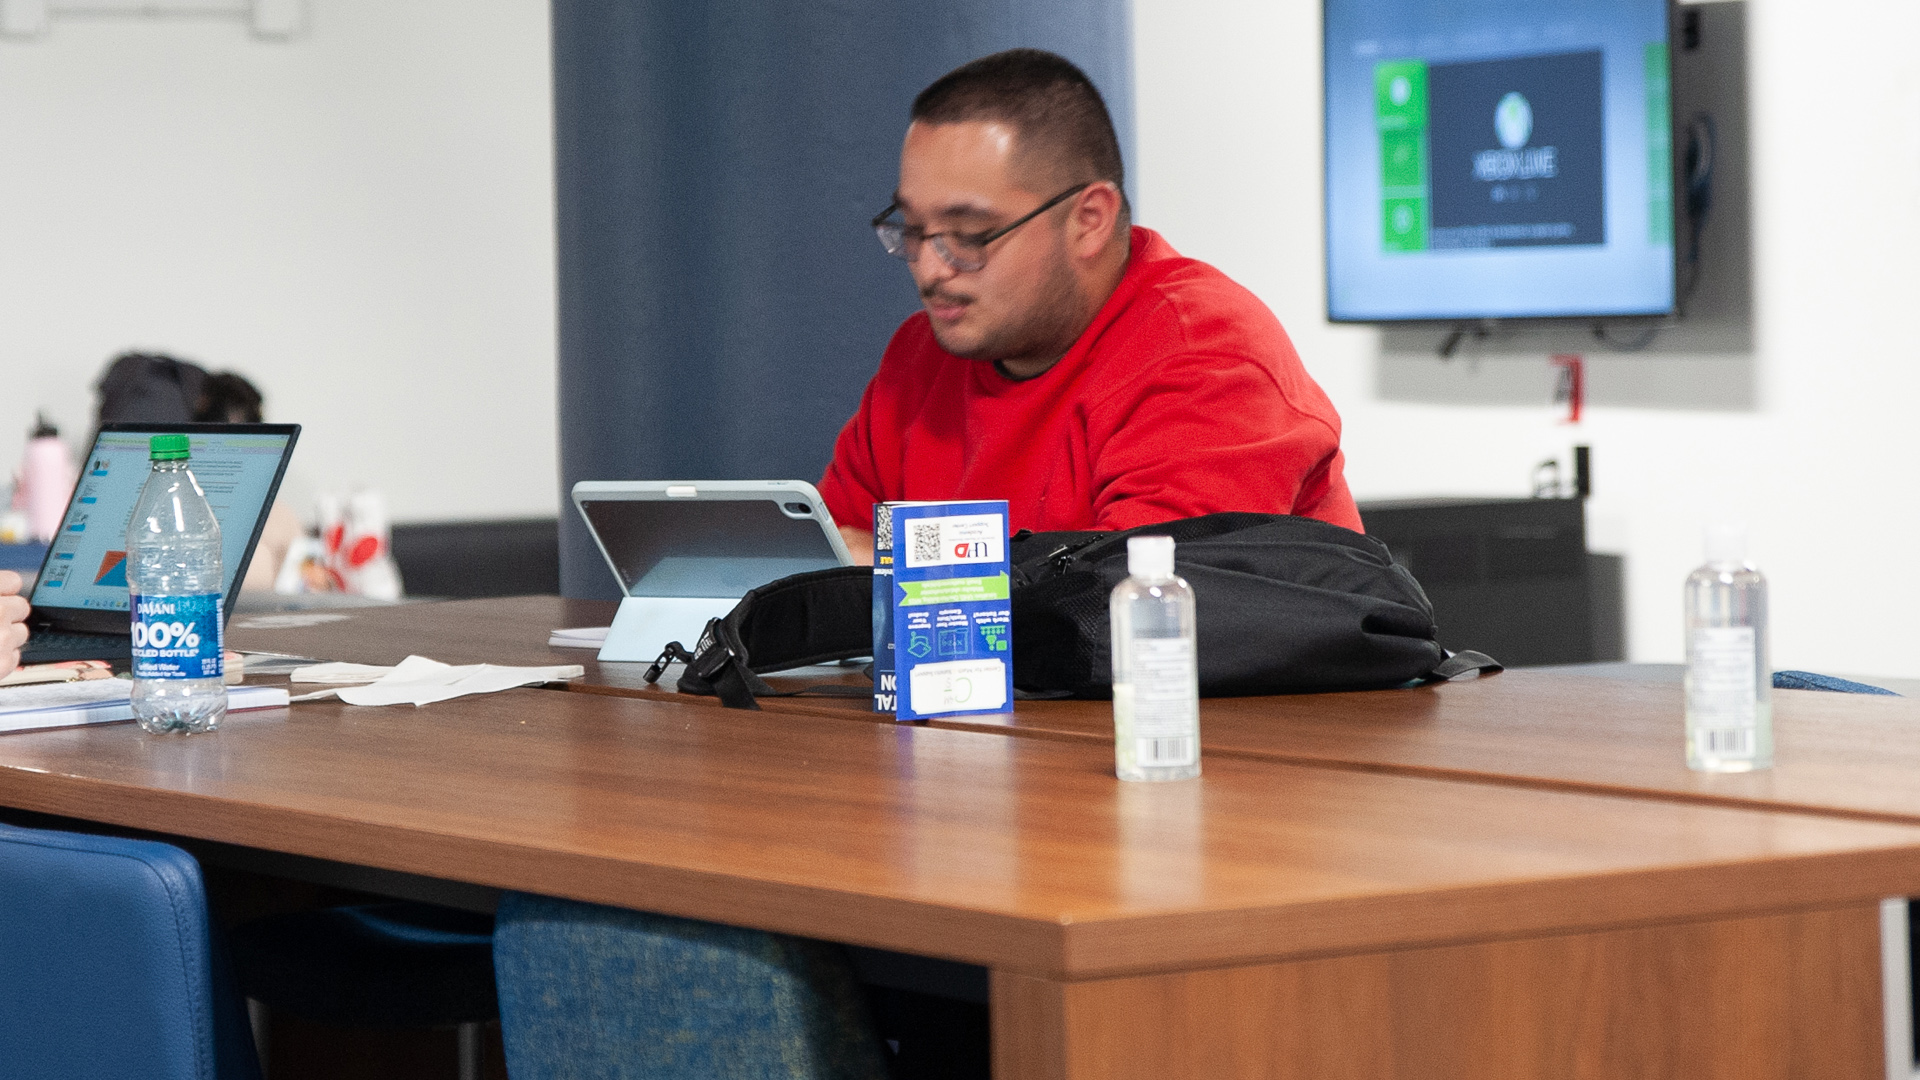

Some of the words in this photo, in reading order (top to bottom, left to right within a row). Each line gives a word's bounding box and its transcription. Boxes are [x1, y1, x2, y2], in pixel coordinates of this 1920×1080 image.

[954, 542, 988, 558] UHD
[137, 601, 176, 616] DASANI
[130, 621, 200, 648] 100%
